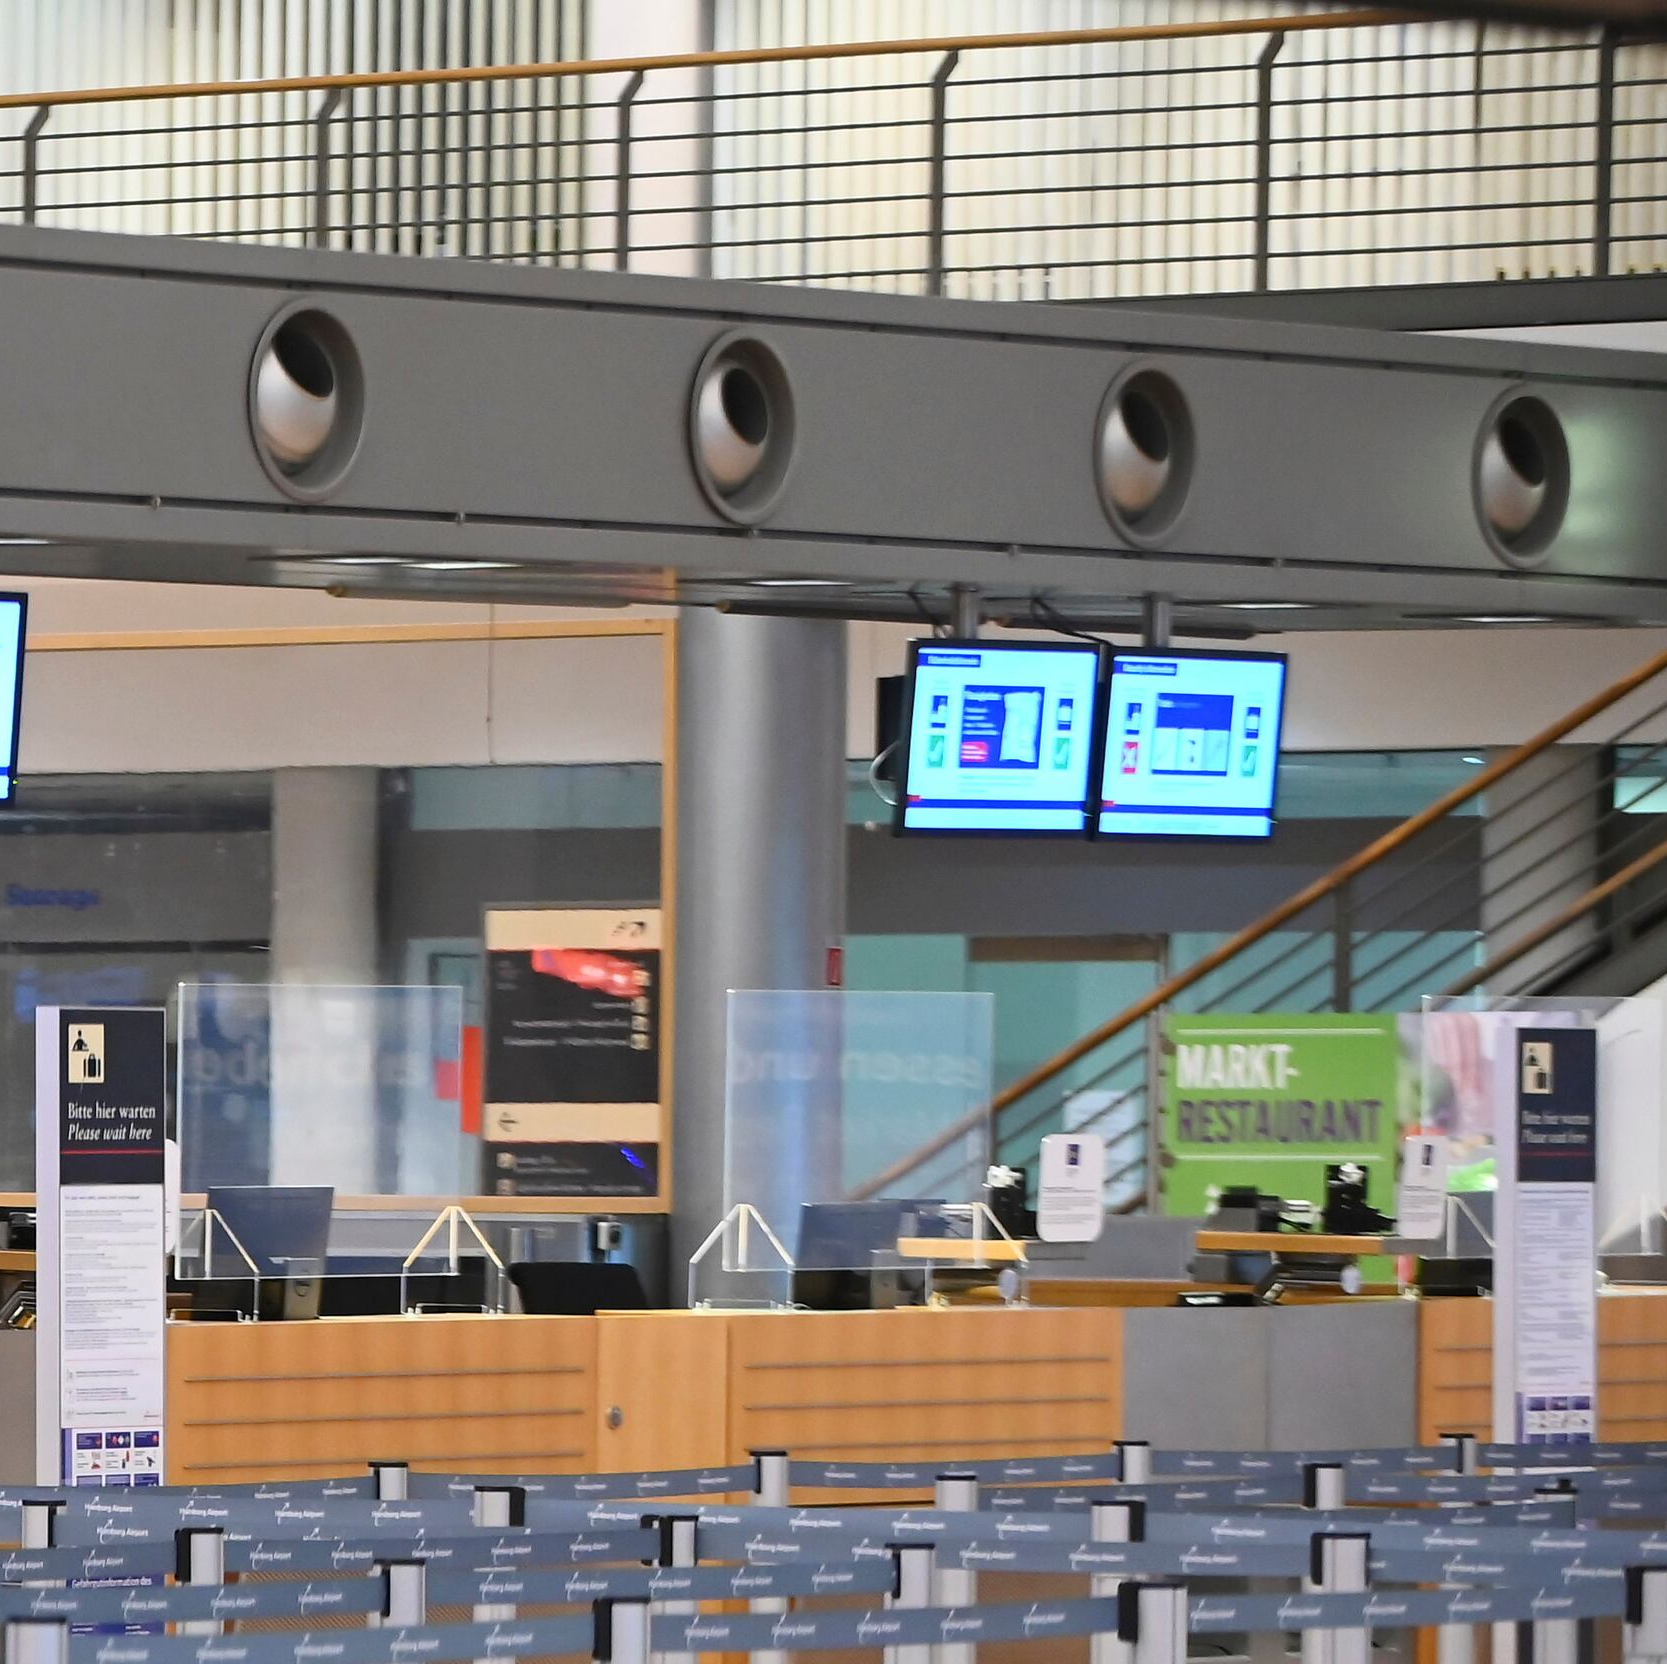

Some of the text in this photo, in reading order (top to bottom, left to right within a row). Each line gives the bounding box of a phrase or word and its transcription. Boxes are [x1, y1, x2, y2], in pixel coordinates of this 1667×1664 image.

[1176, 1043, 1300, 1089] MARKT-
[68, 1101, 155, 1119] Bitte hier warten
[1177, 1099, 1383, 1144] RESTAURANT
[68, 1122, 152, 1140] Please wait here
[96, 1527, 149, 1538] Hamburg Airport
